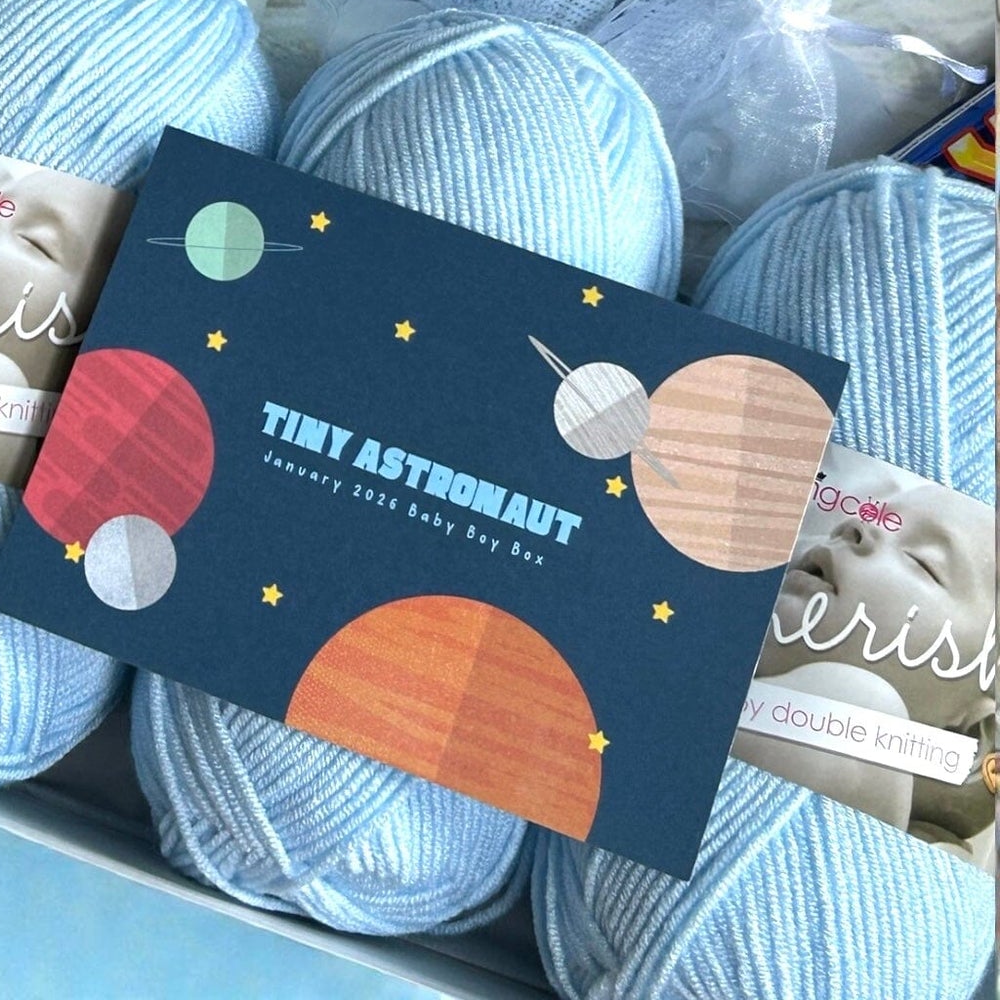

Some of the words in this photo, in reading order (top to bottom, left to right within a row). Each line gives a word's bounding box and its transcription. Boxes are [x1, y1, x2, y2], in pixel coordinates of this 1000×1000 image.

[261, 400, 354, 461] TINY
[352, 438, 583, 545] ASTRONAUT
[263, 450, 342, 494] January
[352, 484, 398, 510] 2026
[407, 503, 456, 536] Baby
[466, 525, 500, 553] Boy
[511, 541, 545, 566] Box
[771, 702, 867, 743] double
[874, 725, 961, 774] knitting
